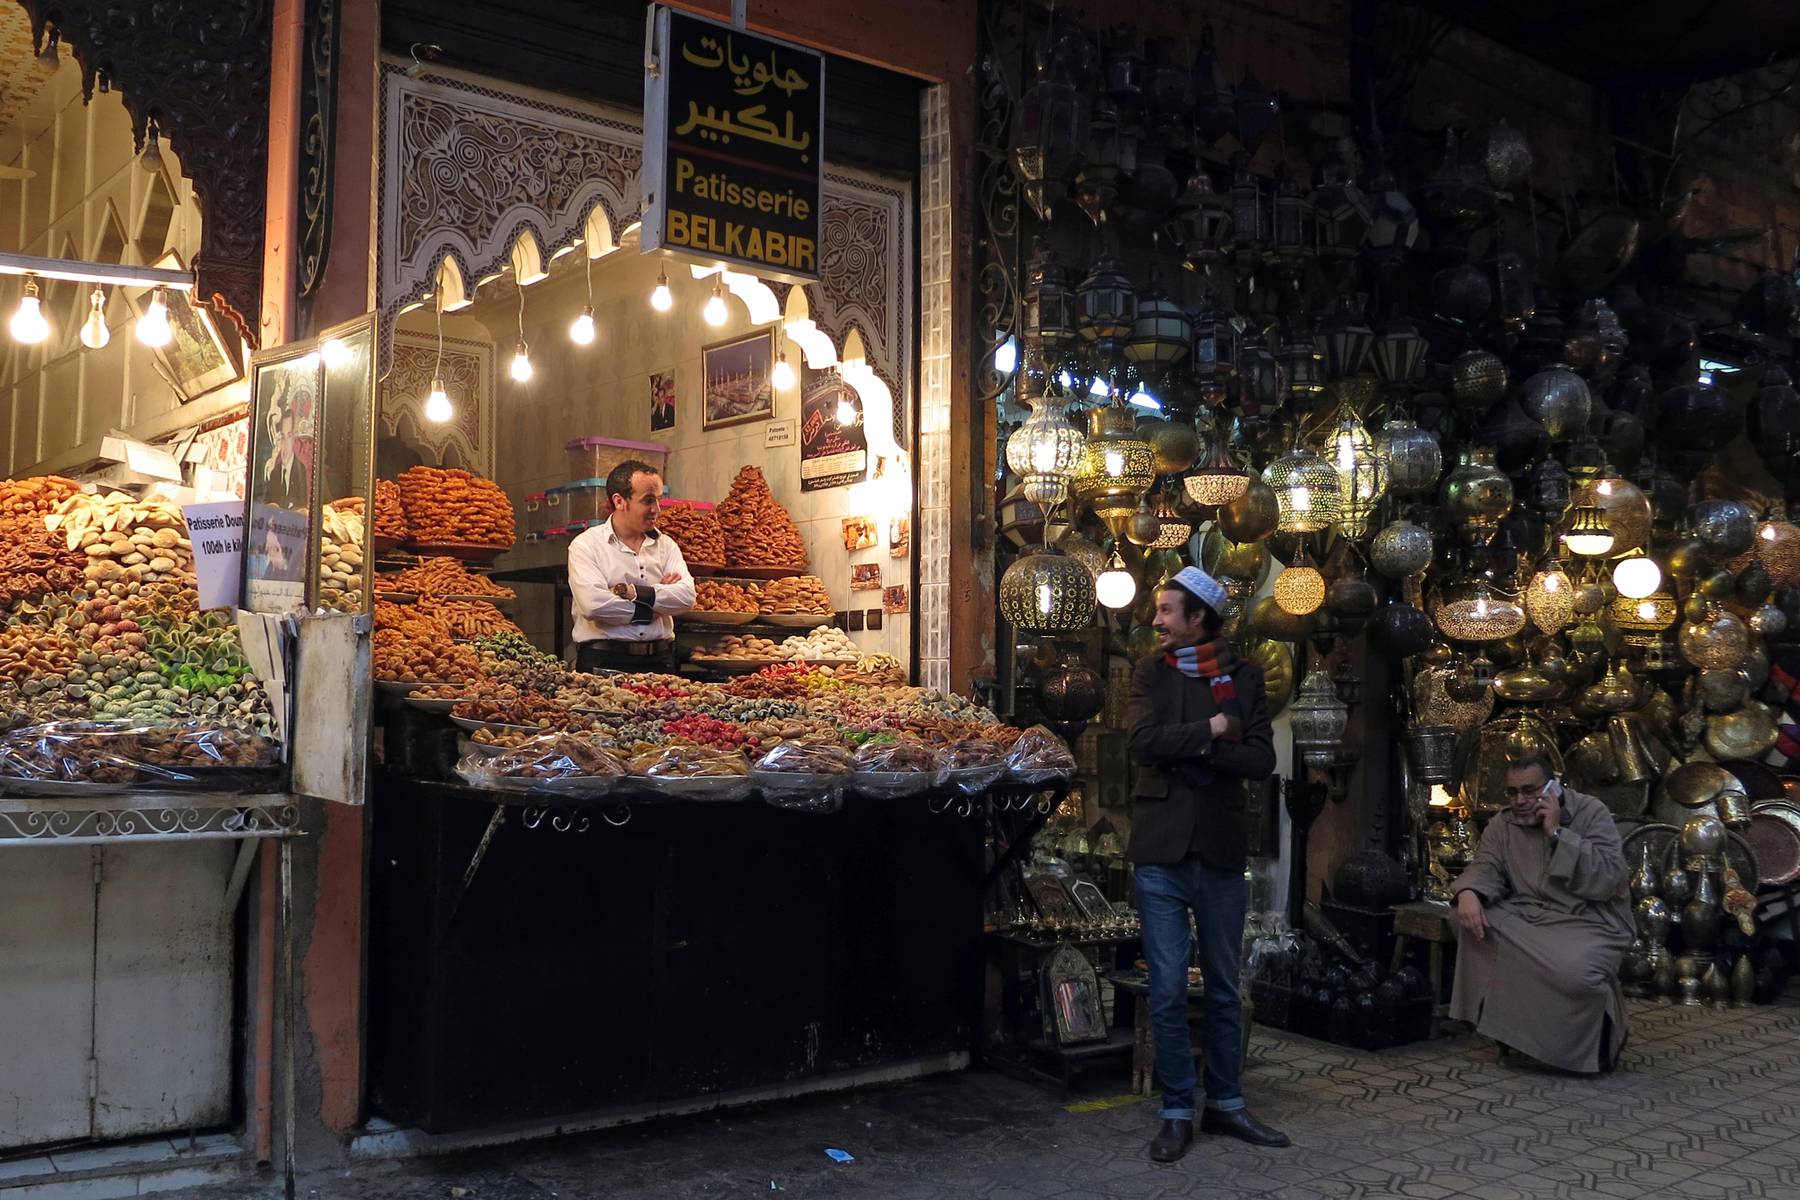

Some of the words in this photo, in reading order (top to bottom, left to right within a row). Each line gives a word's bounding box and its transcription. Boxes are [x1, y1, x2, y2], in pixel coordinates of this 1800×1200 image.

[682, 34, 810, 97] حلويات
[675, 100, 811, 164] بلكبير
[676, 158, 810, 221] Patisserie
[667, 208, 818, 271] BELKABIR
[187, 515, 224, 531] Patisserie
[202, 540, 224, 555] 100dh
[224, 540, 232, 552] le
